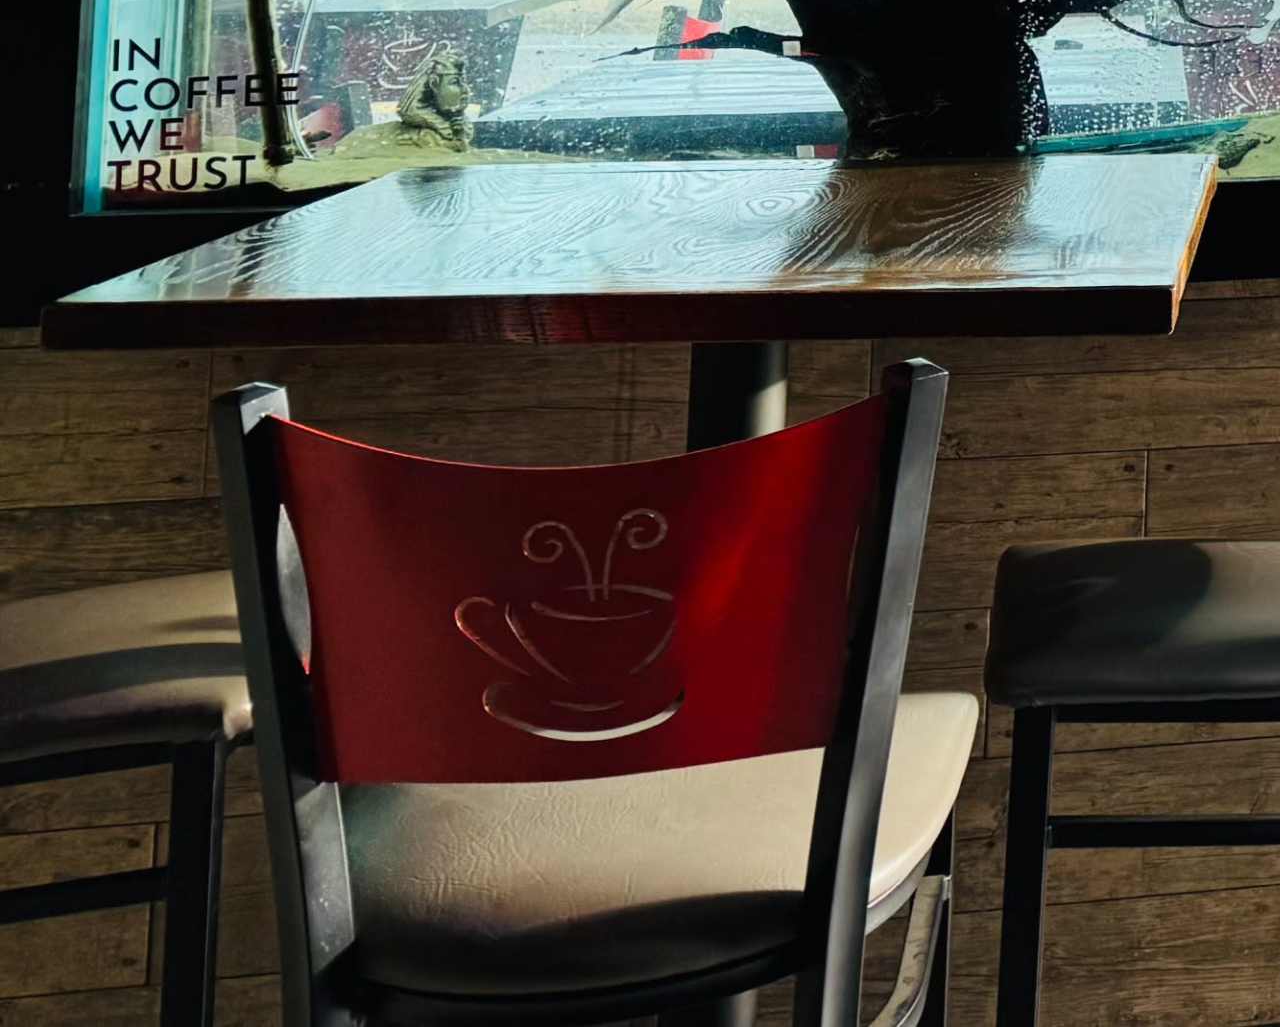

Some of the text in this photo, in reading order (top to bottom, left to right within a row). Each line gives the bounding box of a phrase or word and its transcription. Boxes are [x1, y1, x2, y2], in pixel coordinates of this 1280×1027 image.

[112, 37, 161, 72] IN
[109, 72, 300, 112] COFFEE
[108, 117, 185, 154] WE
[106, 154, 256, 193] TRUST
